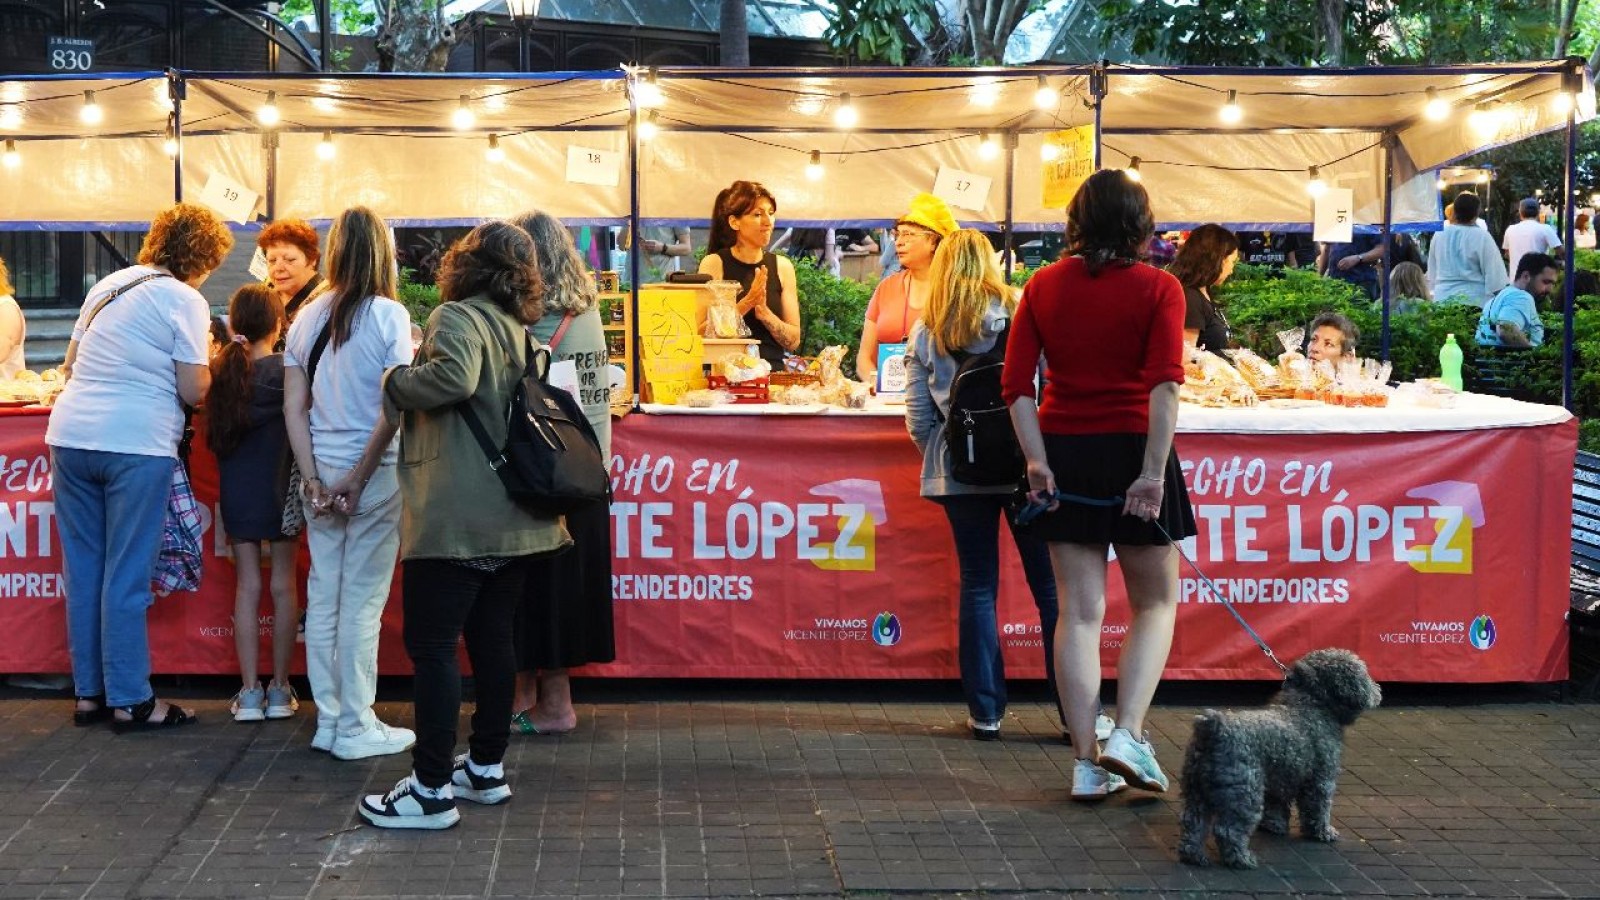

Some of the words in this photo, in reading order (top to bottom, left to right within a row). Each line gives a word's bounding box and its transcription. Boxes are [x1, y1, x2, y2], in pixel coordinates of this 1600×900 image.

[52, 50, 91, 70] 830
[588, 153, 601, 163] 18
[956, 180, 971, 191] 17
[223, 188, 239, 202] 19
[581, 372, 596, 386] OR
[693, 486, 866, 560] LÓPEZ
[1288, 489, 1465, 563] LÓPEZ
[1176, 578, 1350, 603] PRENDEDORES
[814, 618, 868, 629] VIVAMOS
[1411, 621, 1465, 632] VIVAMOS
[783, 629, 830, 640] VICENTE
[833, 628, 867, 641] LÓPEZ
[1380, 633, 1427, 644] VICENTE
[1429, 631, 1465, 644] LÓPEZ
